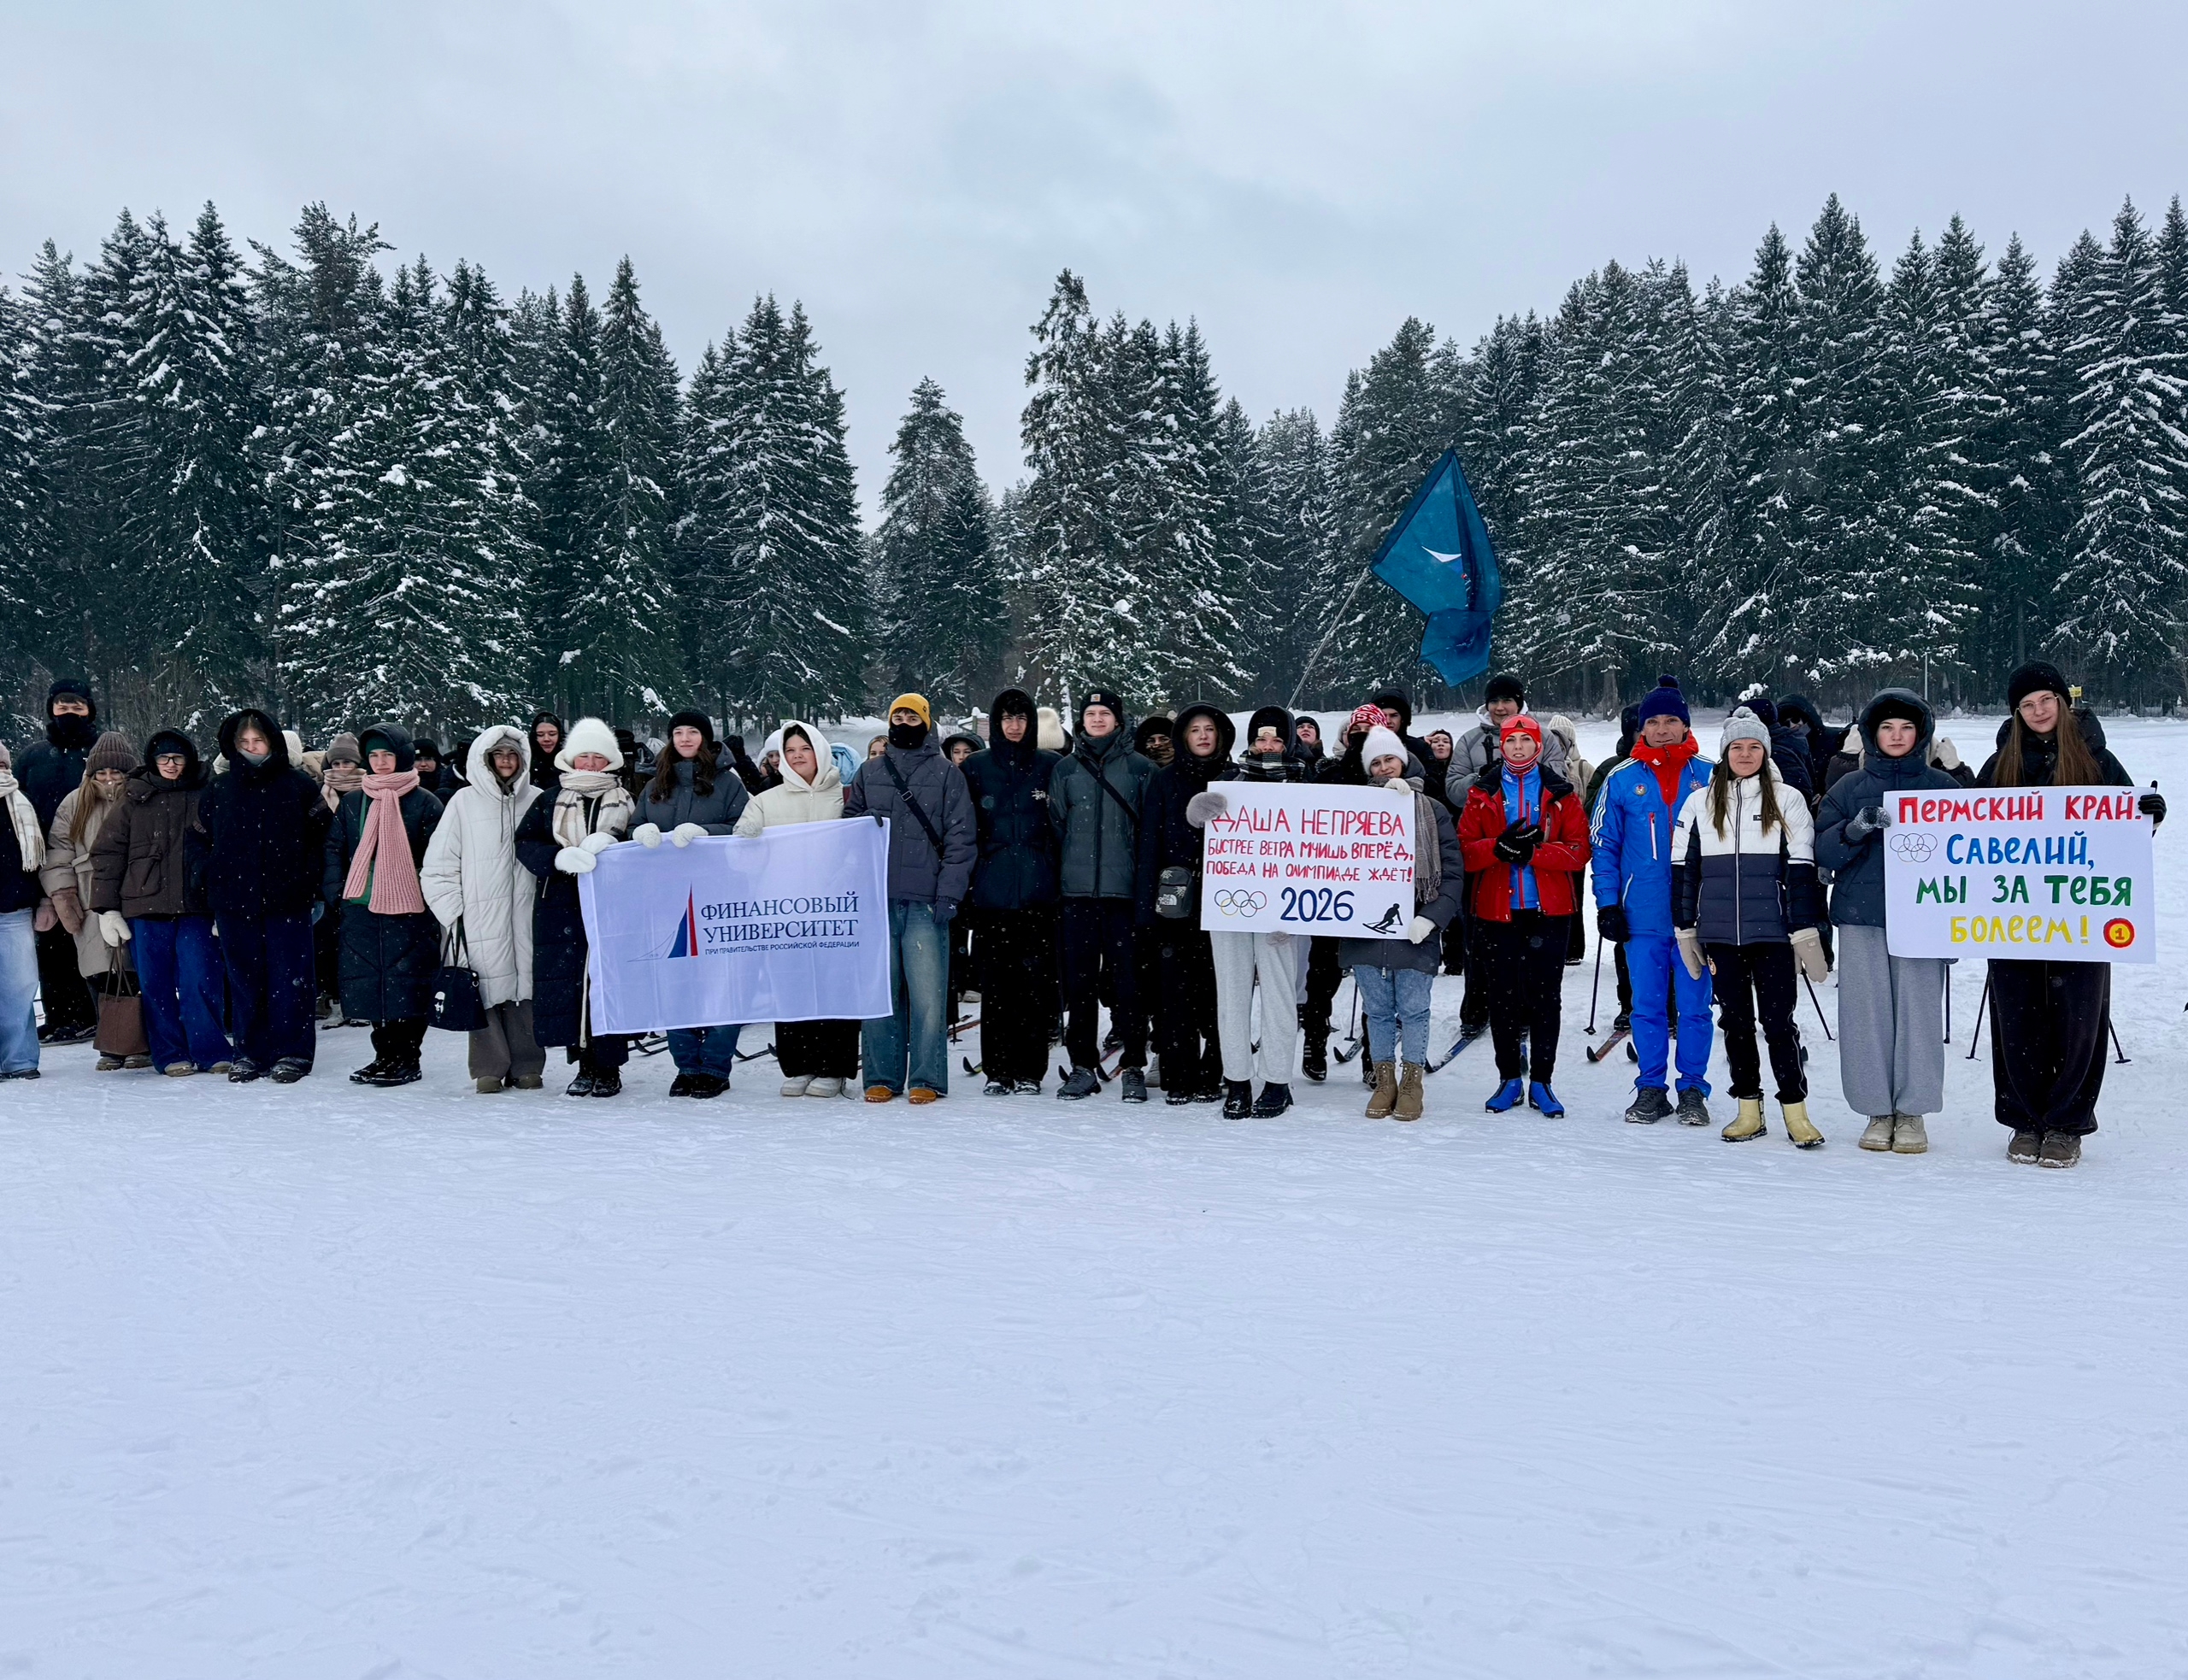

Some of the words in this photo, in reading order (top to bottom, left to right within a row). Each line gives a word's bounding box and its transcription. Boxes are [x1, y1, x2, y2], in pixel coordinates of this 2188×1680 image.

[1211, 805, 1291, 833] ДАША
[1301, 808, 1405, 837] НЕПРЯЕВА
[1208, 838, 1254, 855] БЫСТРЕЕ
[1260, 840, 1295, 858] ВЕТРА
[1300, 841, 1348, 860] МЧИШЬ
[1351, 841, 1414, 861] ВПЕРЁД,
[1206, 861, 1256, 877] ПОБЕДА
[1262, 862, 1279, 878] НА
[1285, 863, 1360, 882] ОЛИМПИАДЕ
[1368, 866, 1413, 883] ЖДЁТ!
[1915, 875, 1967, 904] МЫ
[1991, 875, 2030, 903] ЗА
[701, 891, 859, 920] ФИНАНСОВЫЙ
[1279, 886, 1355, 922] 2026
[703, 919, 859, 943] УНИВЕРСИТЕТ
[2114, 927, 2126, 940] 1
[720, 945, 769, 955] ПРАВИТЕЛЬСТВЕ
[770, 941, 817, 951] РОССИЙСКОЙ
[819, 941, 860, 949] ФЕДЕРАЦИИ
